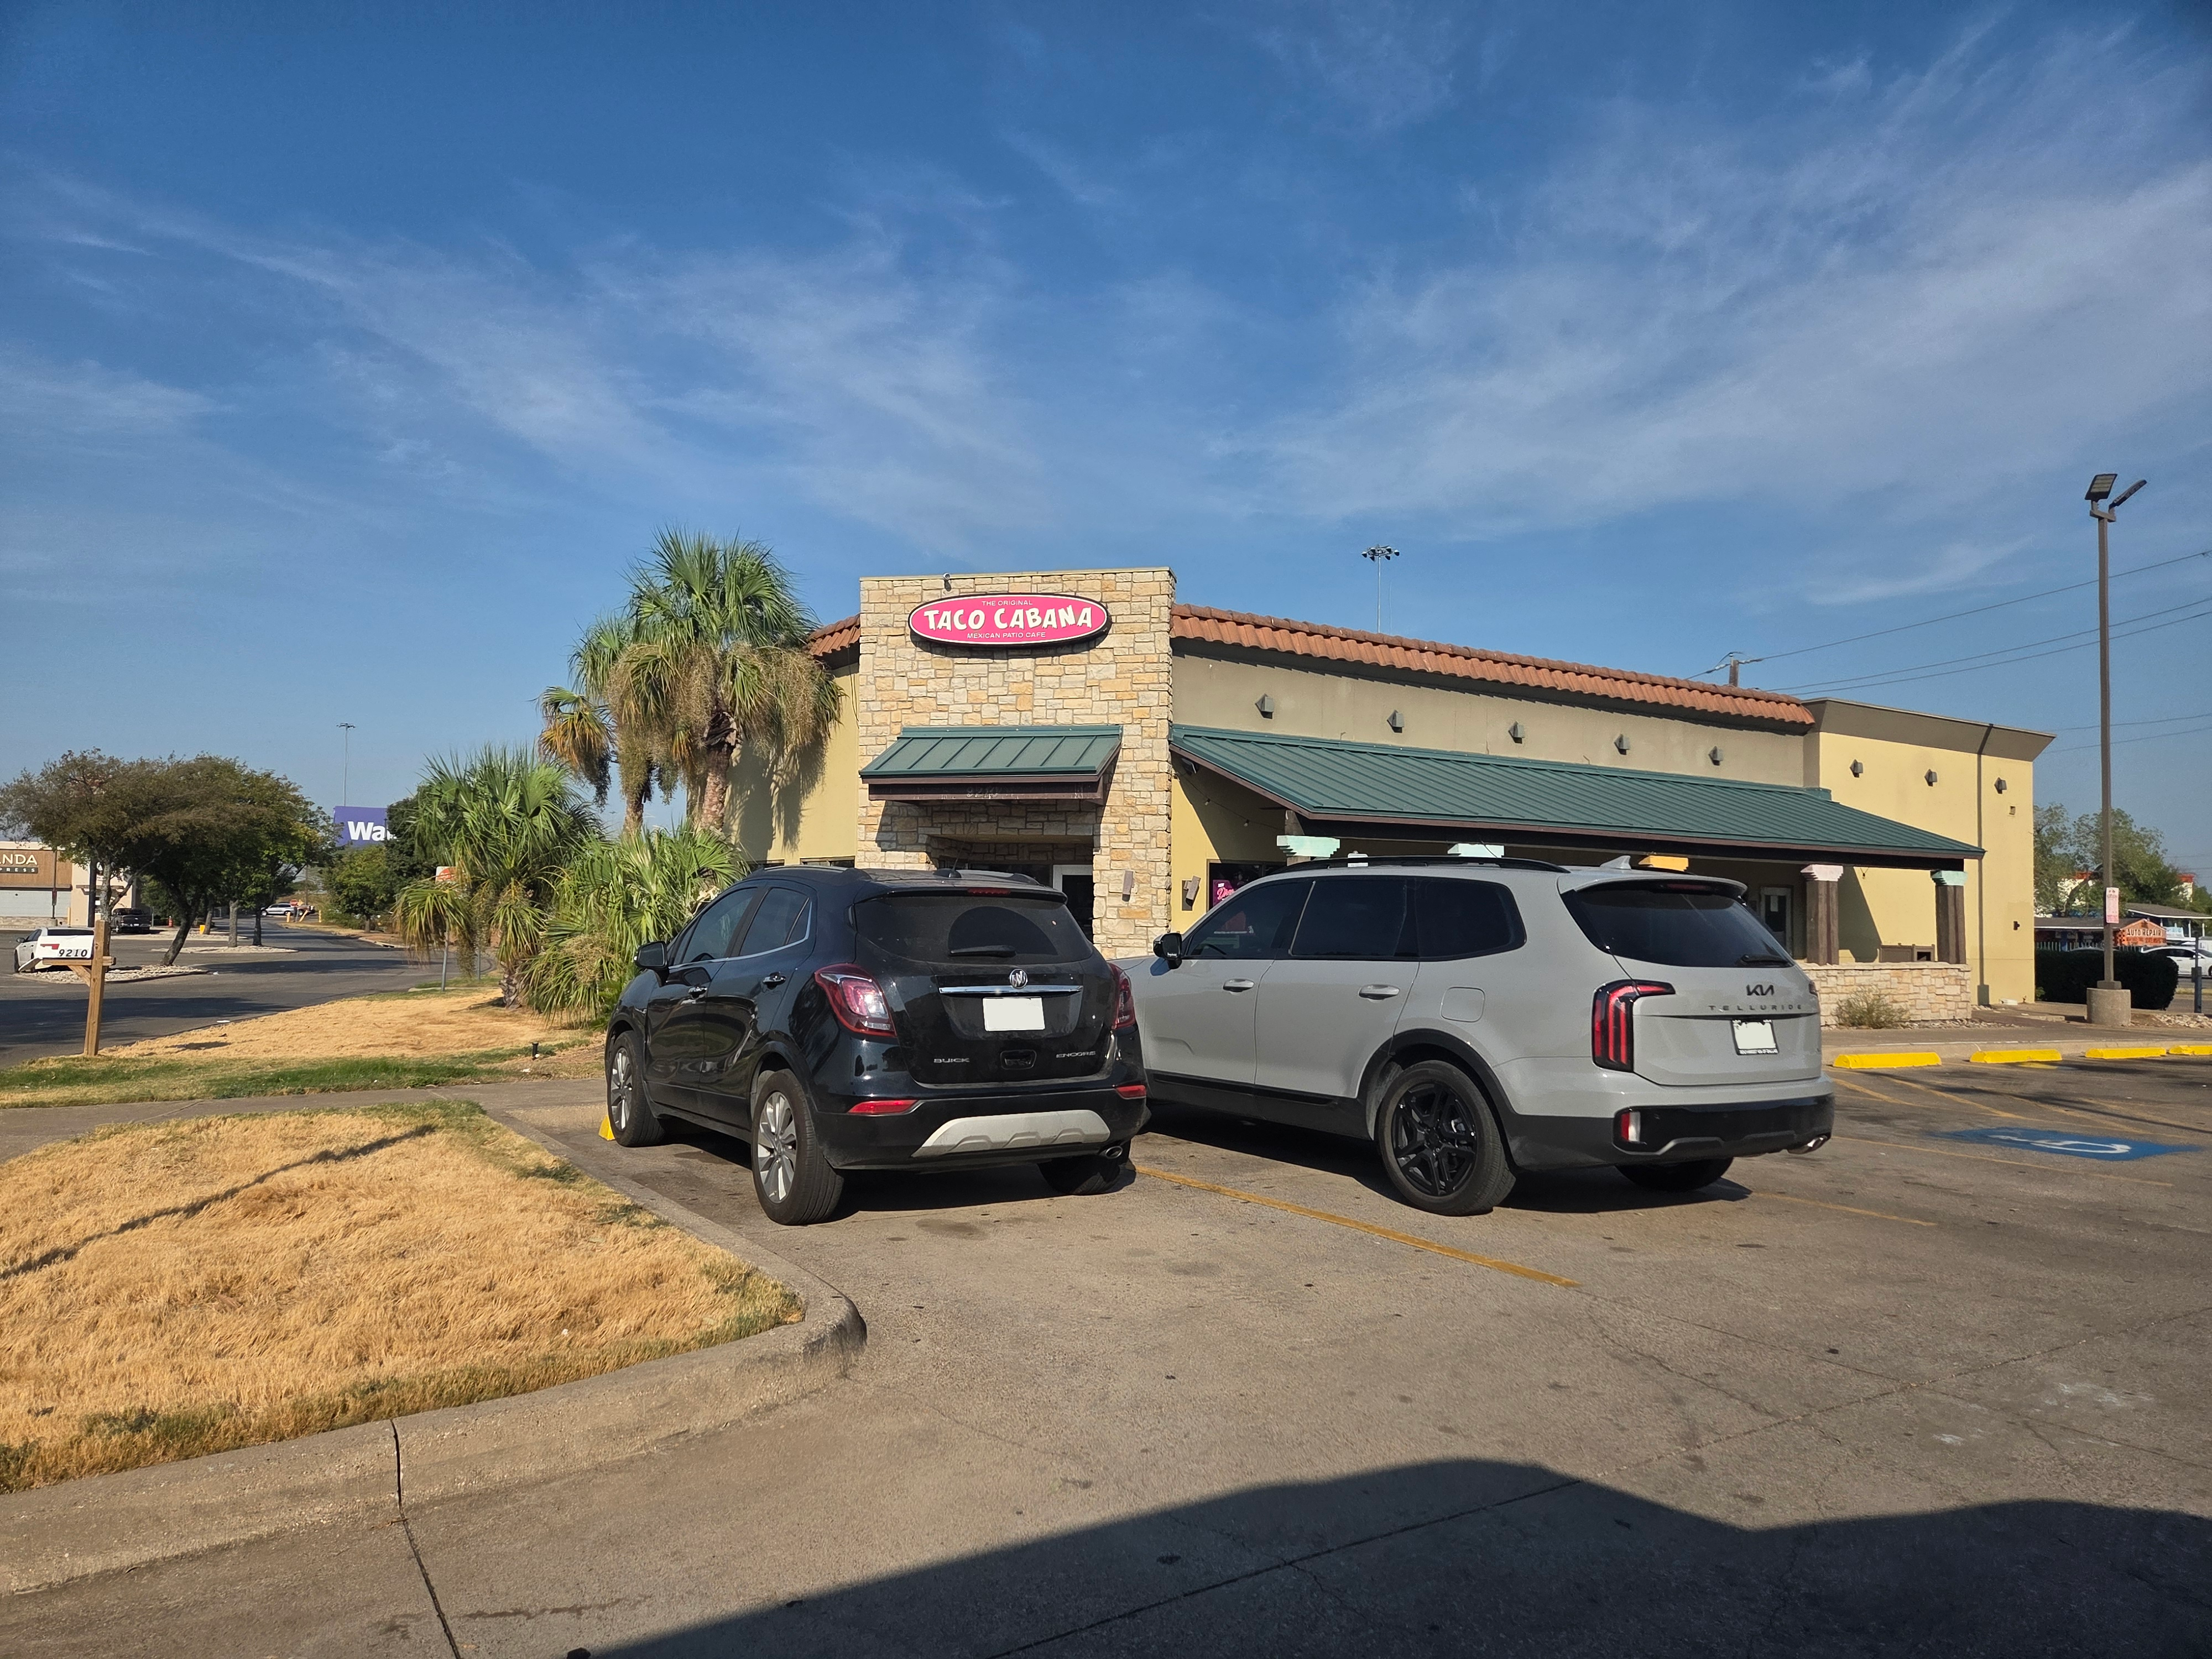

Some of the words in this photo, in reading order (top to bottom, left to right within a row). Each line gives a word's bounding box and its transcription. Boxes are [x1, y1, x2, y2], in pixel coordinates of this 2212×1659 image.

[924, 609, 985, 631] TACO
[994, 604, 1093, 630] CABANA
[0, 853, 38, 865] NDA
